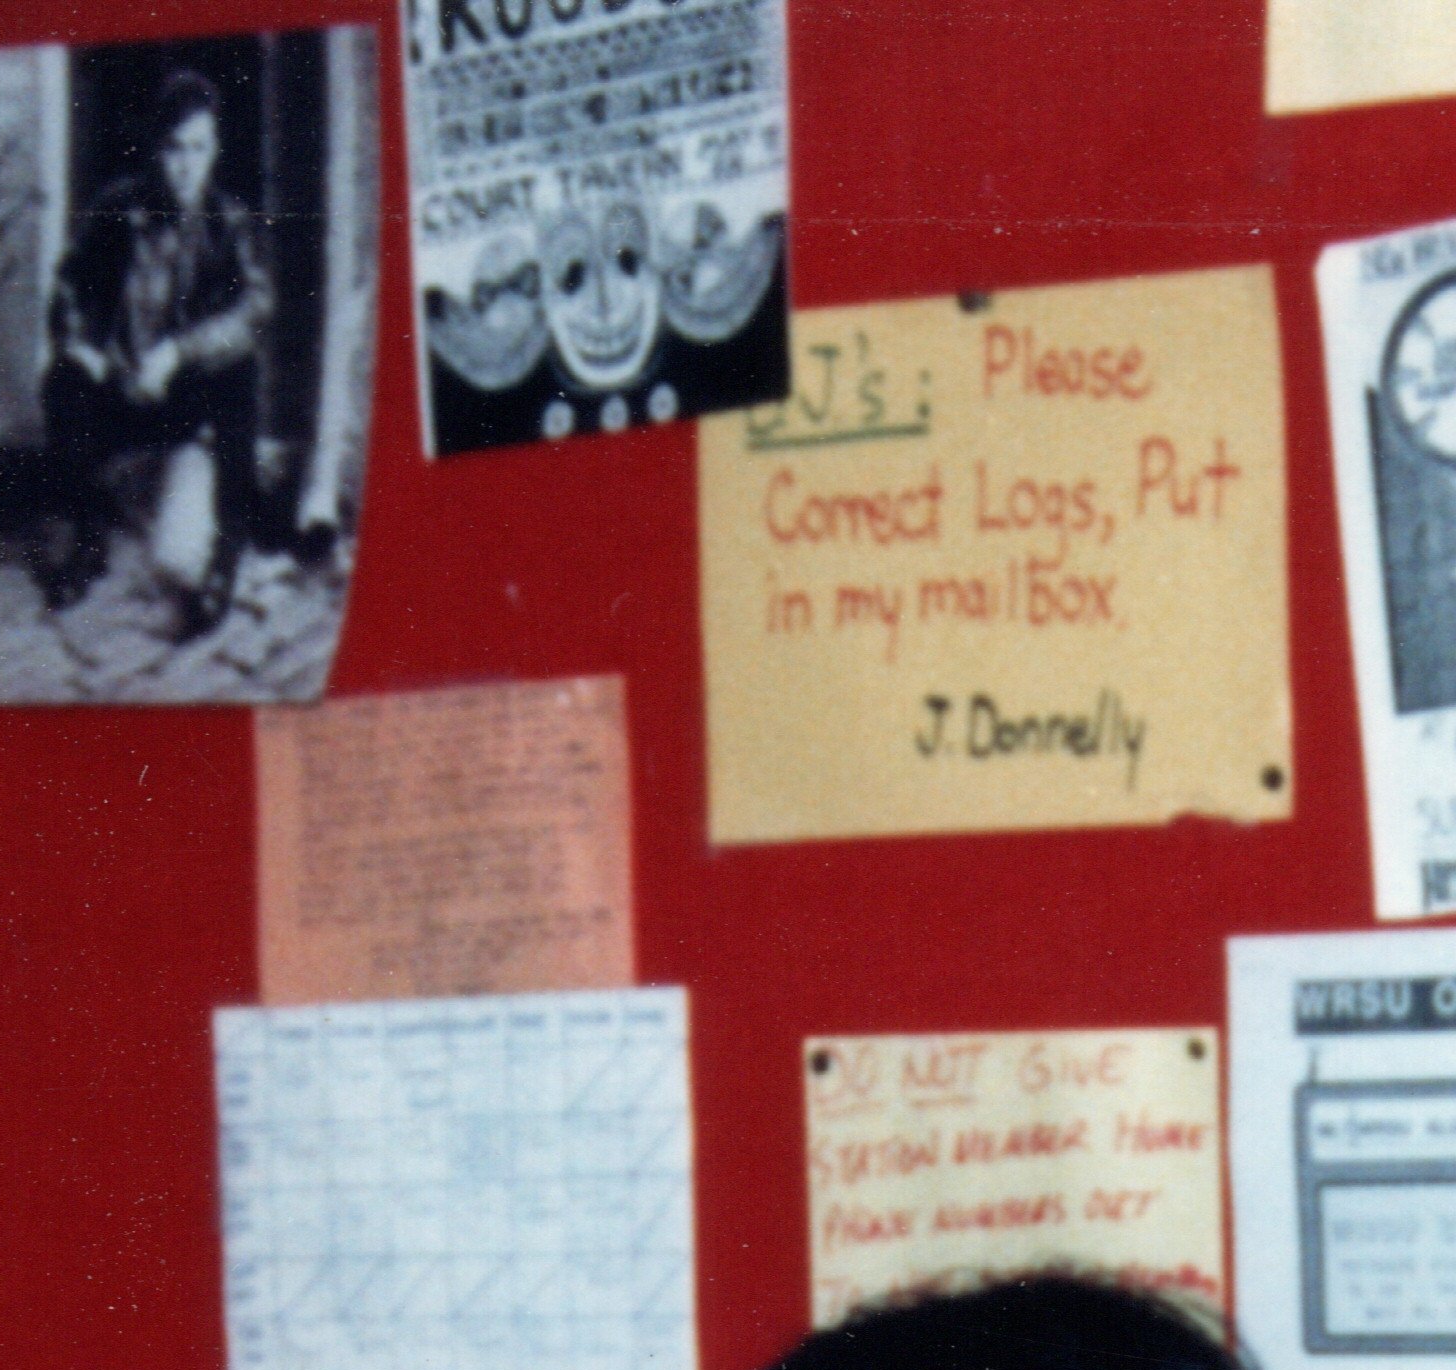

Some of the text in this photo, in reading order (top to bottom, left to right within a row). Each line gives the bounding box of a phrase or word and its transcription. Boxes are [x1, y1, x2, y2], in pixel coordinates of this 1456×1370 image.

[980, 323, 1153, 400] Please
[760, 436, 1243, 565] Correct Logs, Put
[763, 571, 816, 635] in
[833, 583, 903, 664] my
[968, 688, 1149, 788] Donnelly
[1294, 979, 1413, 1022] WRSU
